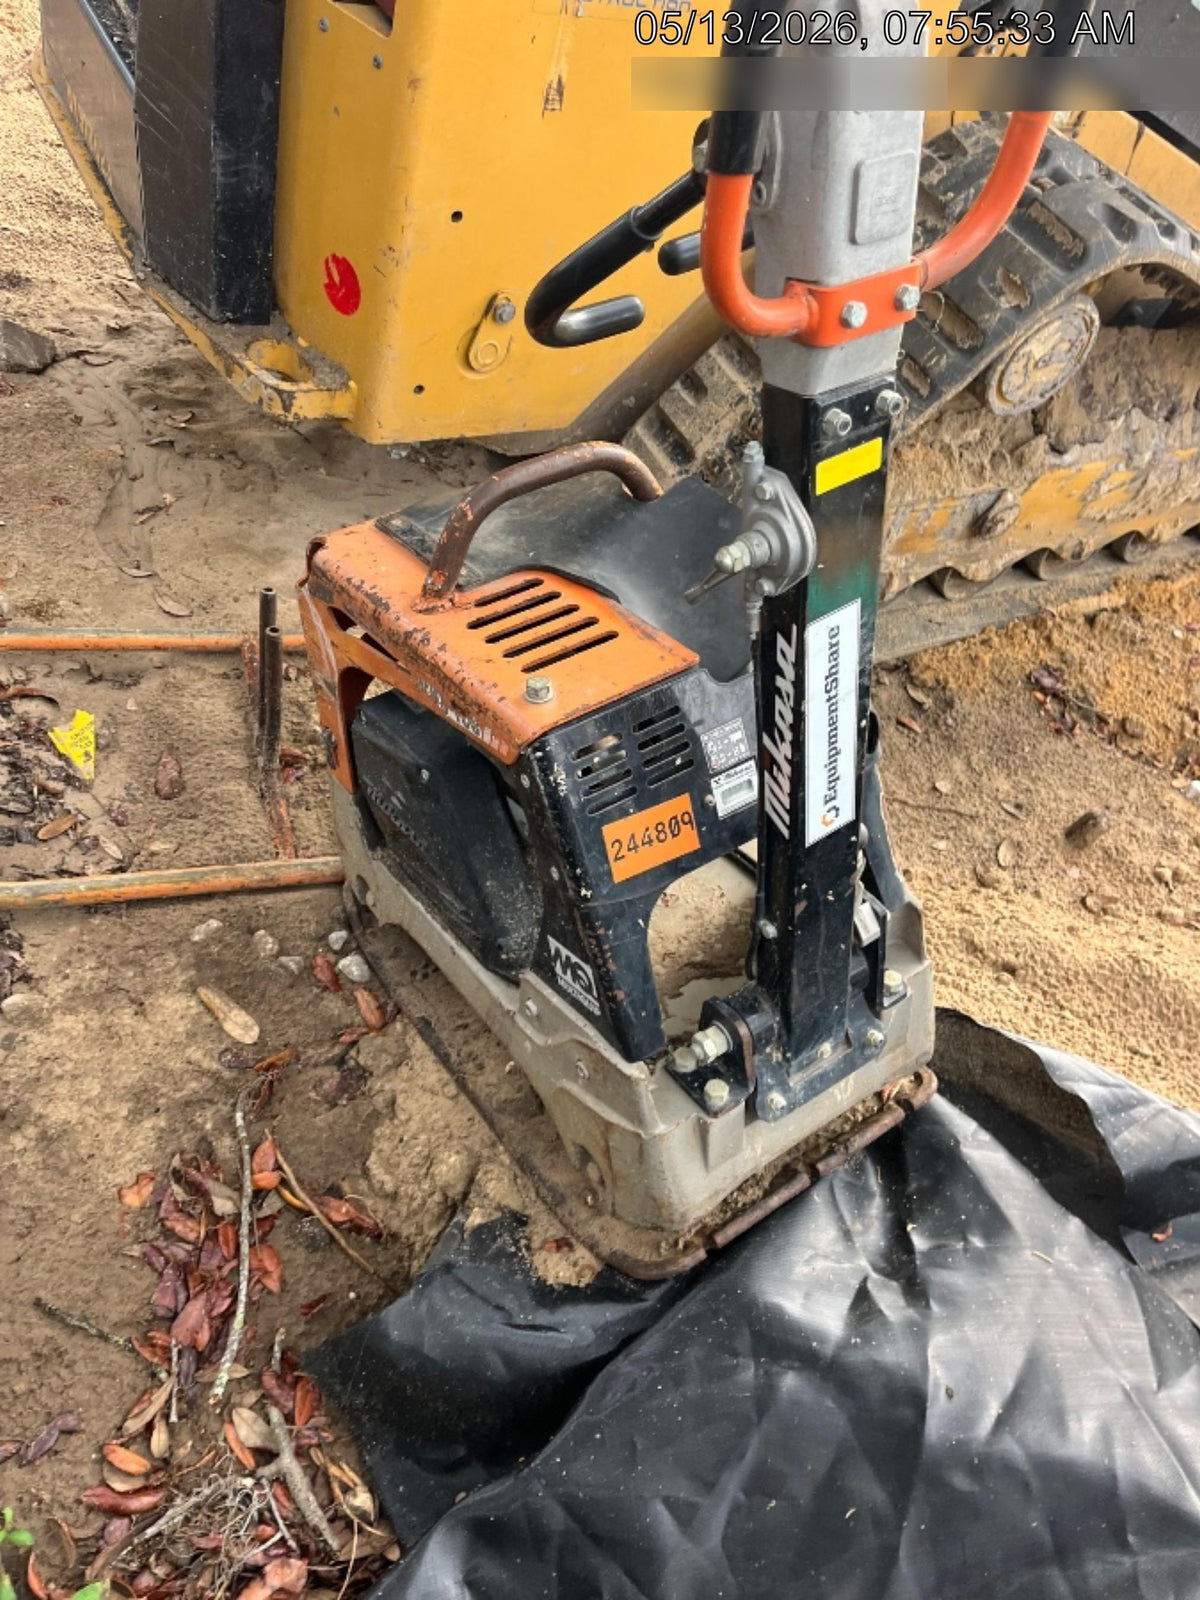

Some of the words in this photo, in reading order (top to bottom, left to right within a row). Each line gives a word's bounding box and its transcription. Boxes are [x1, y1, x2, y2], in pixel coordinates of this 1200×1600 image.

[763, 624, 797, 840] Mikasa
[824, 624, 840, 807] EquipmentShare
[611, 811, 694, 862] 244809
